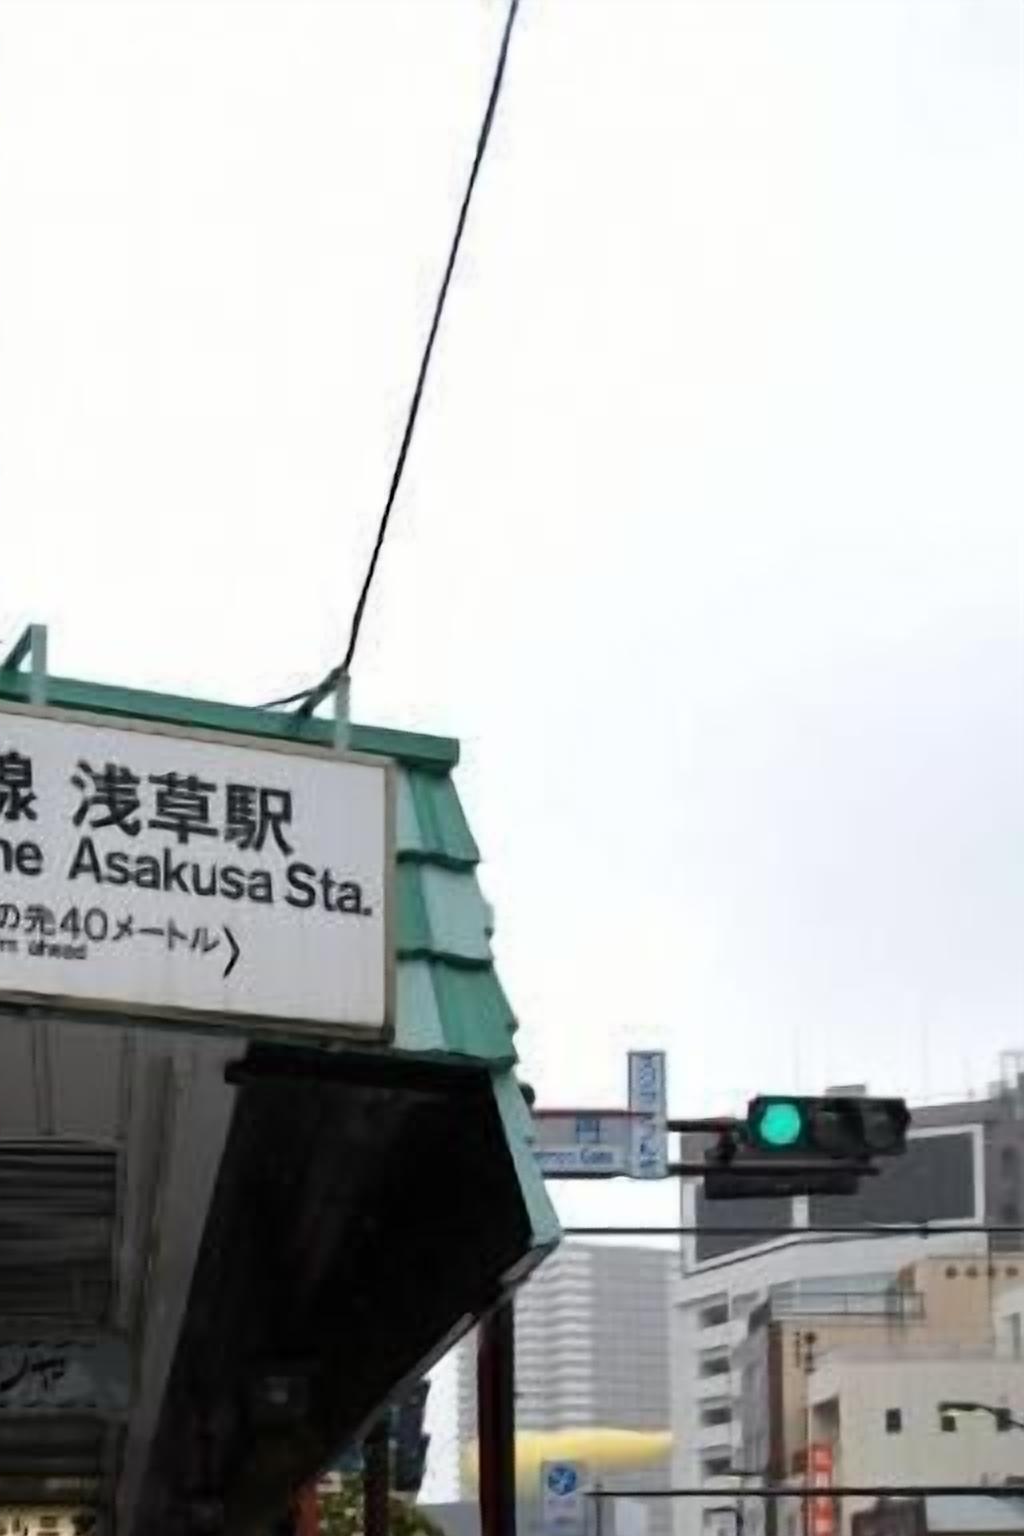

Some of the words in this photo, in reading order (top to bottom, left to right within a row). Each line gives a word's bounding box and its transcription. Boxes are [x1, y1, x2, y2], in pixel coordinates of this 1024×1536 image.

[70, 759, 294, 856] 浅草駅
[68, 835, 274, 905] Asakusa
[284, 862, 374, 917] Sta.
